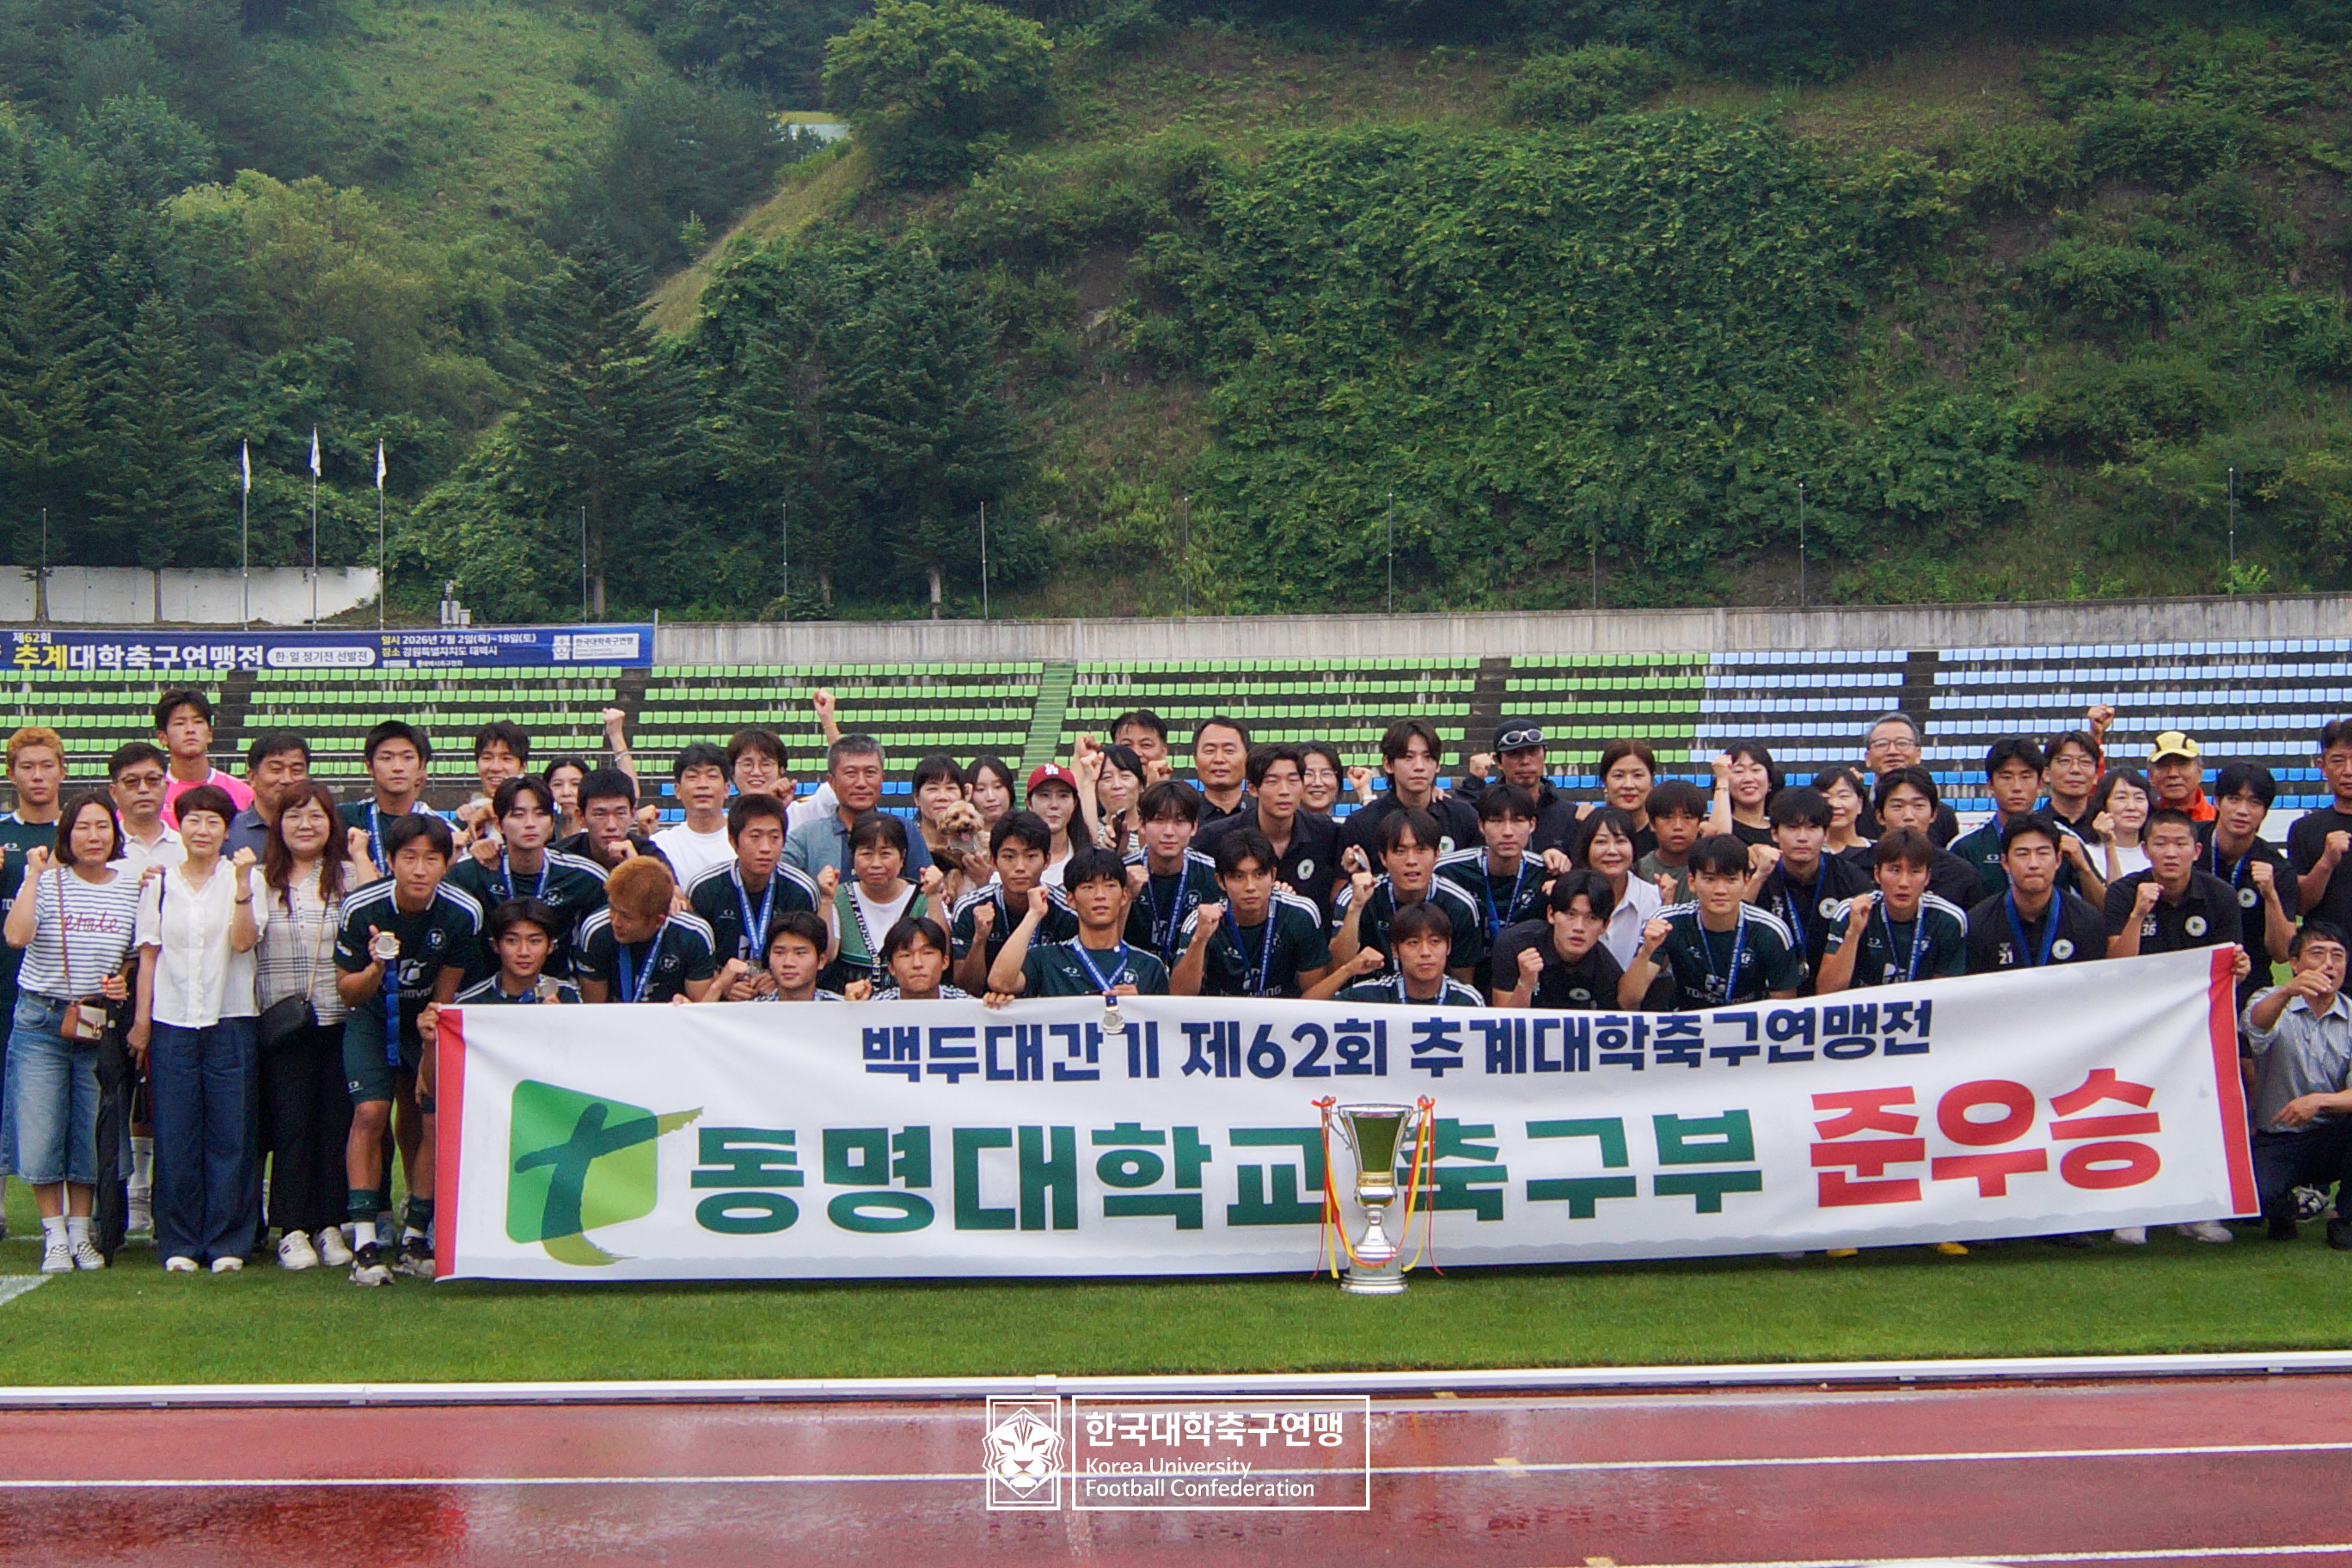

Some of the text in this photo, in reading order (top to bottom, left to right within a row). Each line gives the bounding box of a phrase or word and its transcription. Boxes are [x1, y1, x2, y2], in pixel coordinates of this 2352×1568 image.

[12, 632, 52, 645] 제62회
[381, 635, 401, 645] 일시
[402, 634, 438, 645] 2026년
[439, 634, 456, 645] 7월
[13, 644, 263, 671] 추계대학축구연맹전
[302, 651, 334, 663] 정기전
[336, 651, 368, 663] 선발전
[861, 999, 1933, 1084] 백두대간기 제62회 추계대학축구연맹전
[690, 1068, 2161, 1234] 동명대학교 축구부 준우승
